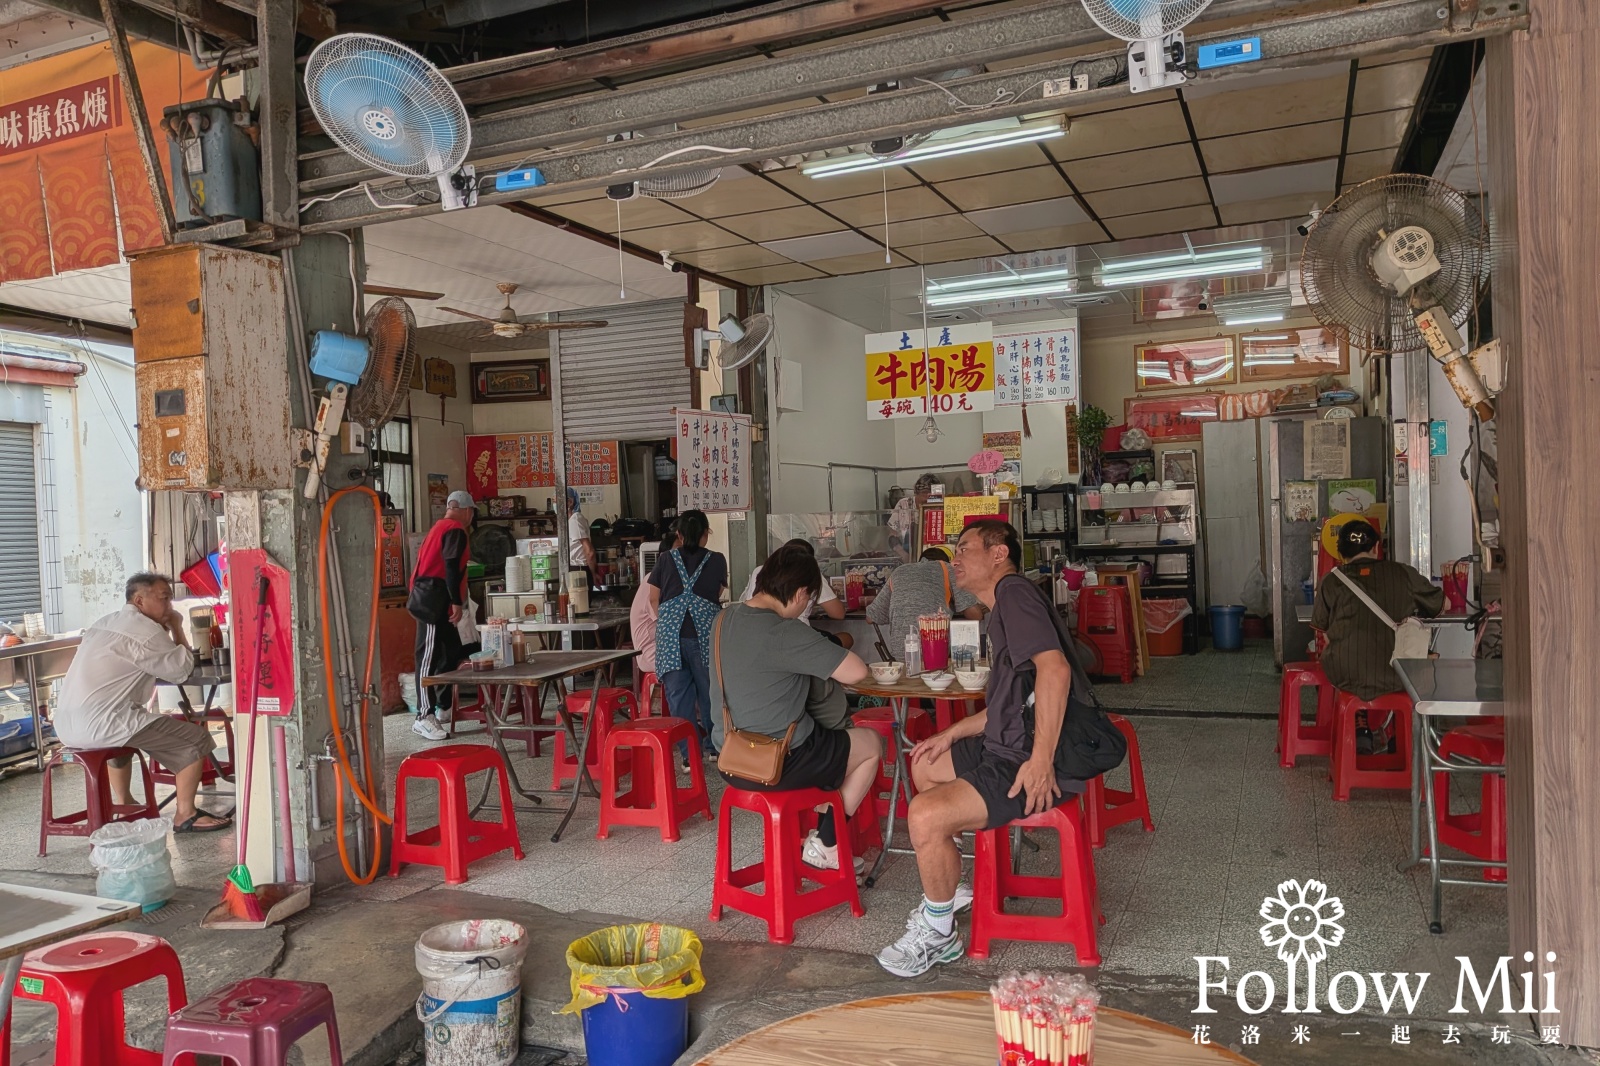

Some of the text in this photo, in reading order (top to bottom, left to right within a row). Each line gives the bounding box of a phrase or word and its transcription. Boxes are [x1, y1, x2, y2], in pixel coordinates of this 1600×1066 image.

[898, 327, 952, 351] 土產
[1033, 337, 1043, 384] 牛肉湯
[874, 345, 986, 399] 牛肉湯
[996, 343, 1007, 387] 白飯
[681, 418, 690, 487] 白飯
[711, 420, 719, 488] 牛肉湯
